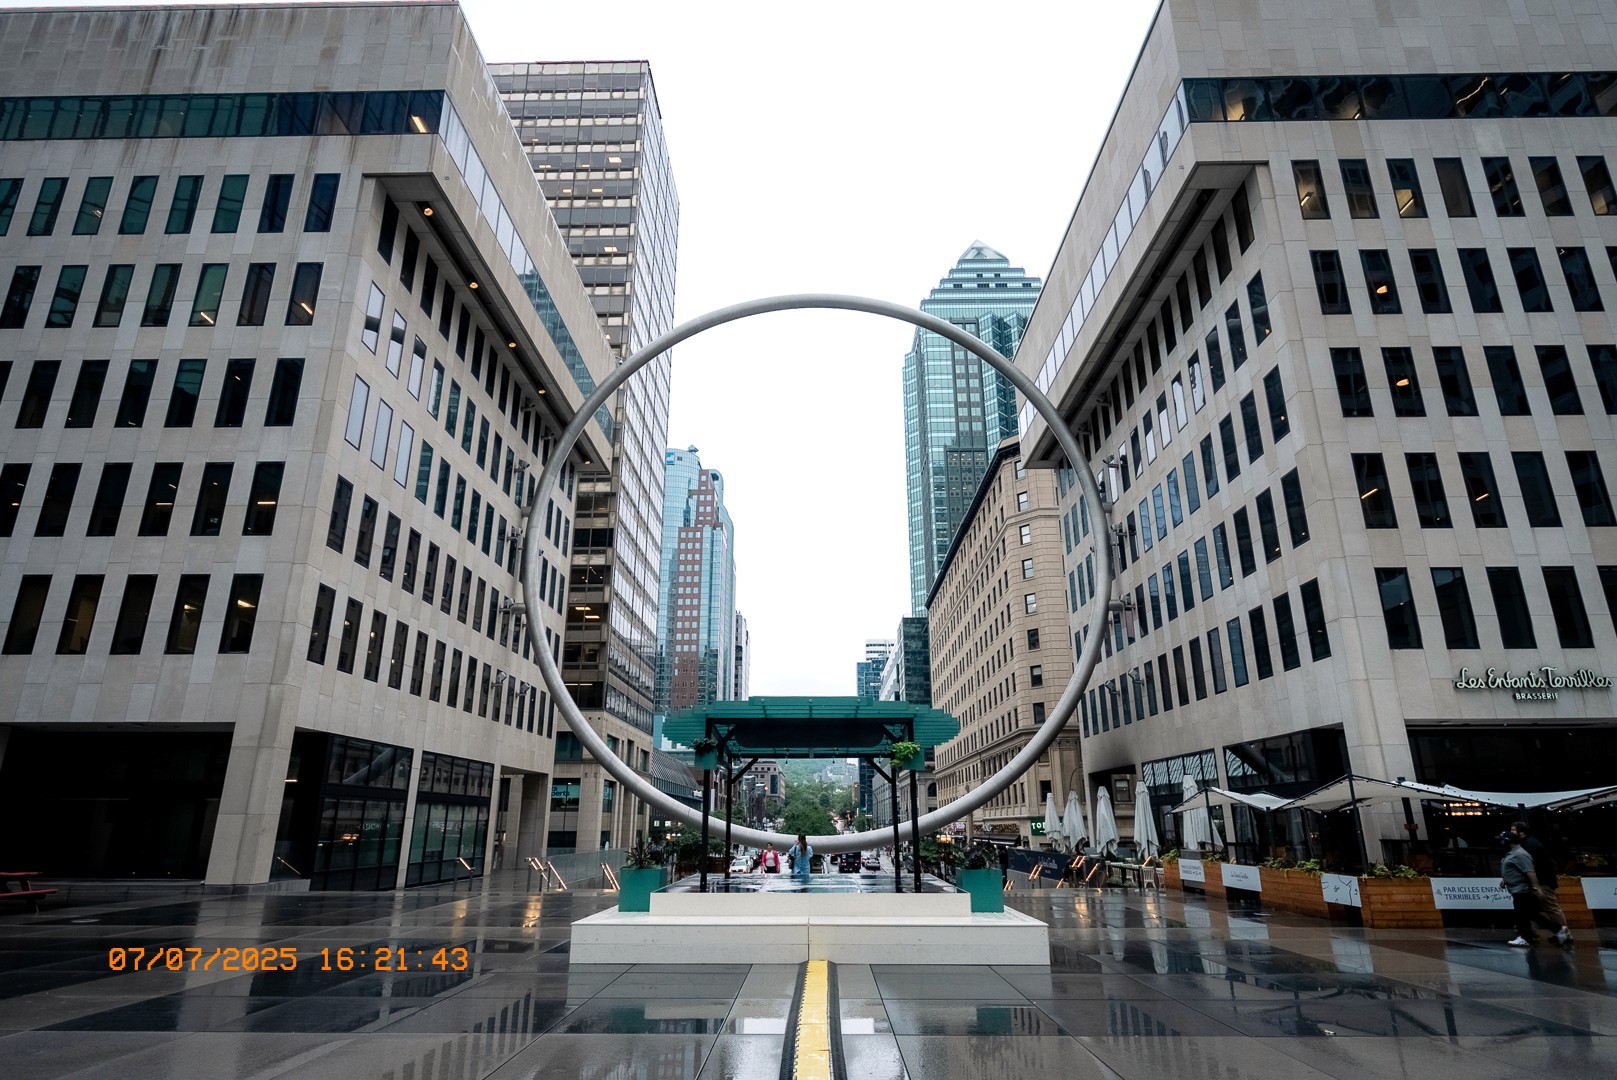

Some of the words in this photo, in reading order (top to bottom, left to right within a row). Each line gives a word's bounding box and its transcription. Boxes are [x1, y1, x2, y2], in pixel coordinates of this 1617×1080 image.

[1457, 667, 1486, 688] Les
[1487, 667, 1546, 688] Enfants
[1515, 692, 1559, 700] BRASSERIE
[1444, 893, 1481, 901] TERRIBLES
